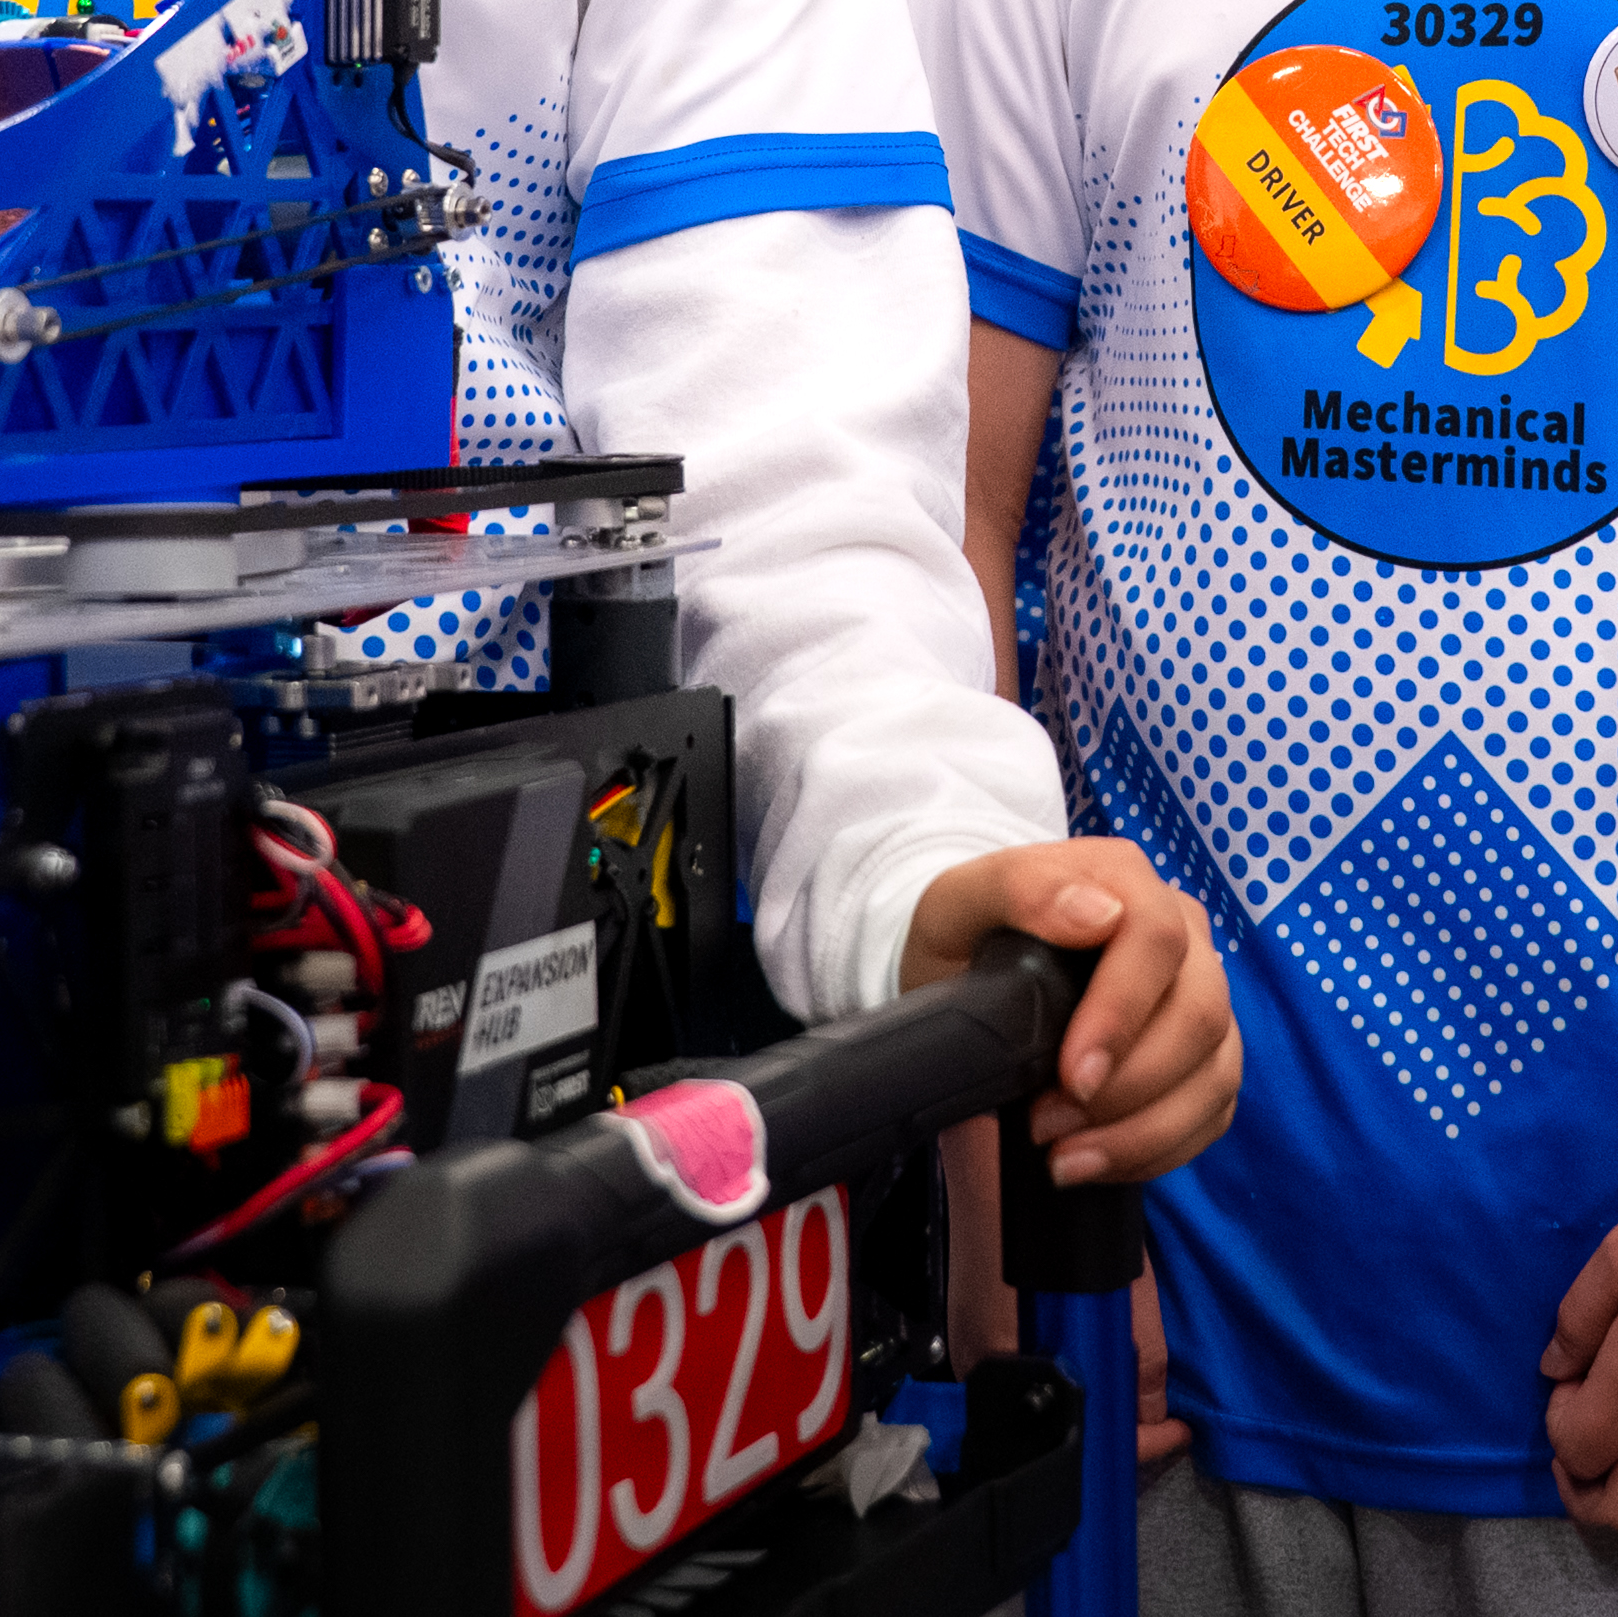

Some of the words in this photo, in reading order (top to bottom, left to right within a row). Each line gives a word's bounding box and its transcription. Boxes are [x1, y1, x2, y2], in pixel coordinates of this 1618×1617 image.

[1381, 2, 1543, 47] 30329
[1321, 118, 1365, 172] TECH
[1332, 103, 1389, 162] FIRST
[1288, 109, 1373, 214] CHALLENGE
[1246, 149, 1326, 246] DRIVER
[1303, 389, 1587, 445] Mechanical
[1281, 437, 1609, 494] Masterminds
[480, 942, 590, 1009] EXPANSION
[411, 979, 468, 1032] REV
[472, 1004, 523, 1053] HUB
